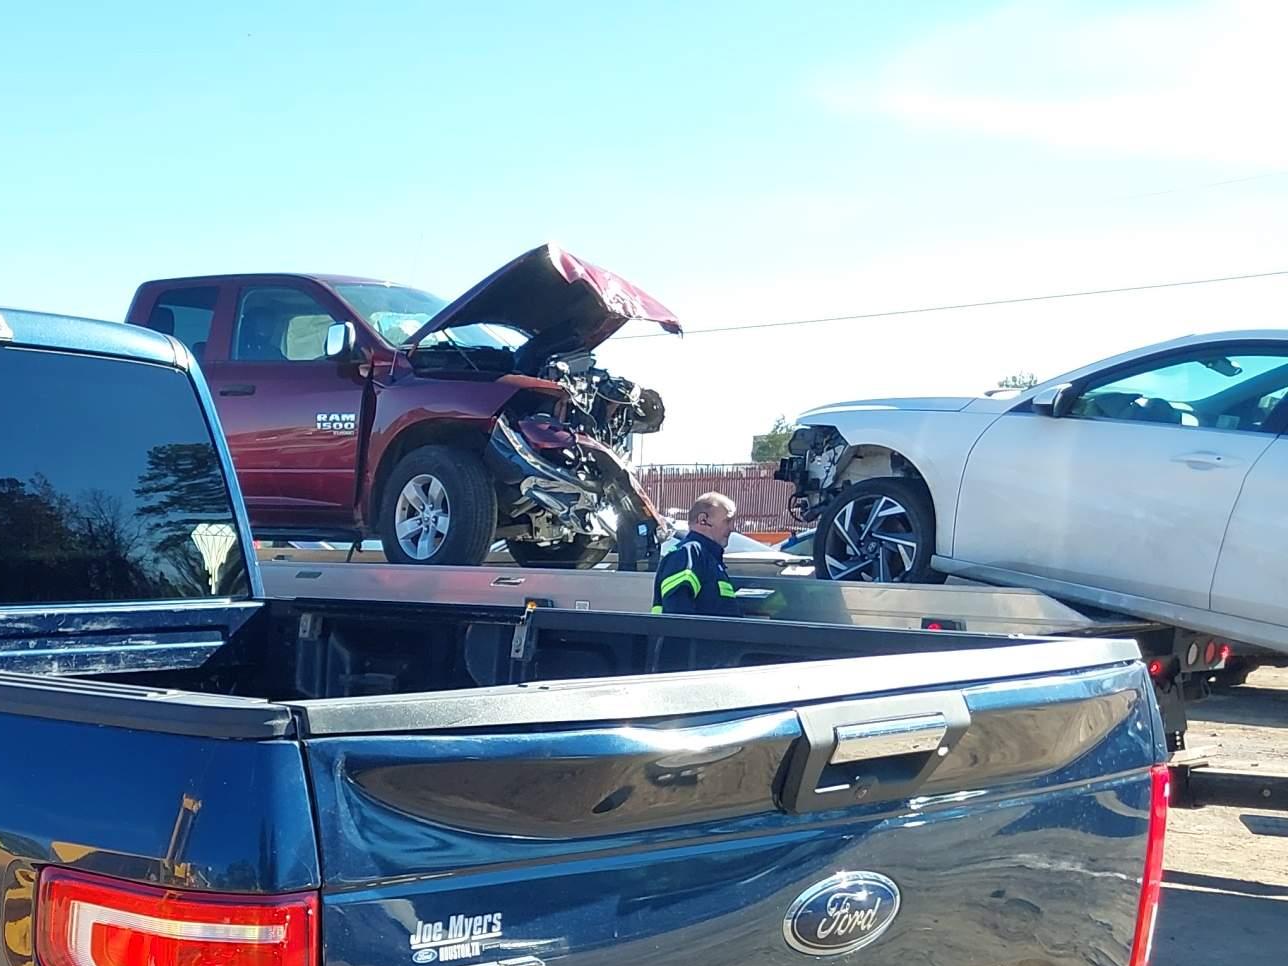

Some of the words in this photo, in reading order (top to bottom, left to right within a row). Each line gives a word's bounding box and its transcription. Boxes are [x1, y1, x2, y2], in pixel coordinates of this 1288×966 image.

[316, 413, 356, 422] RAM
[316, 422, 355, 430] 1500
[816, 891, 881, 940] Ford
[409, 920, 444, 945] Joe
[447, 912, 503, 940] Myers
